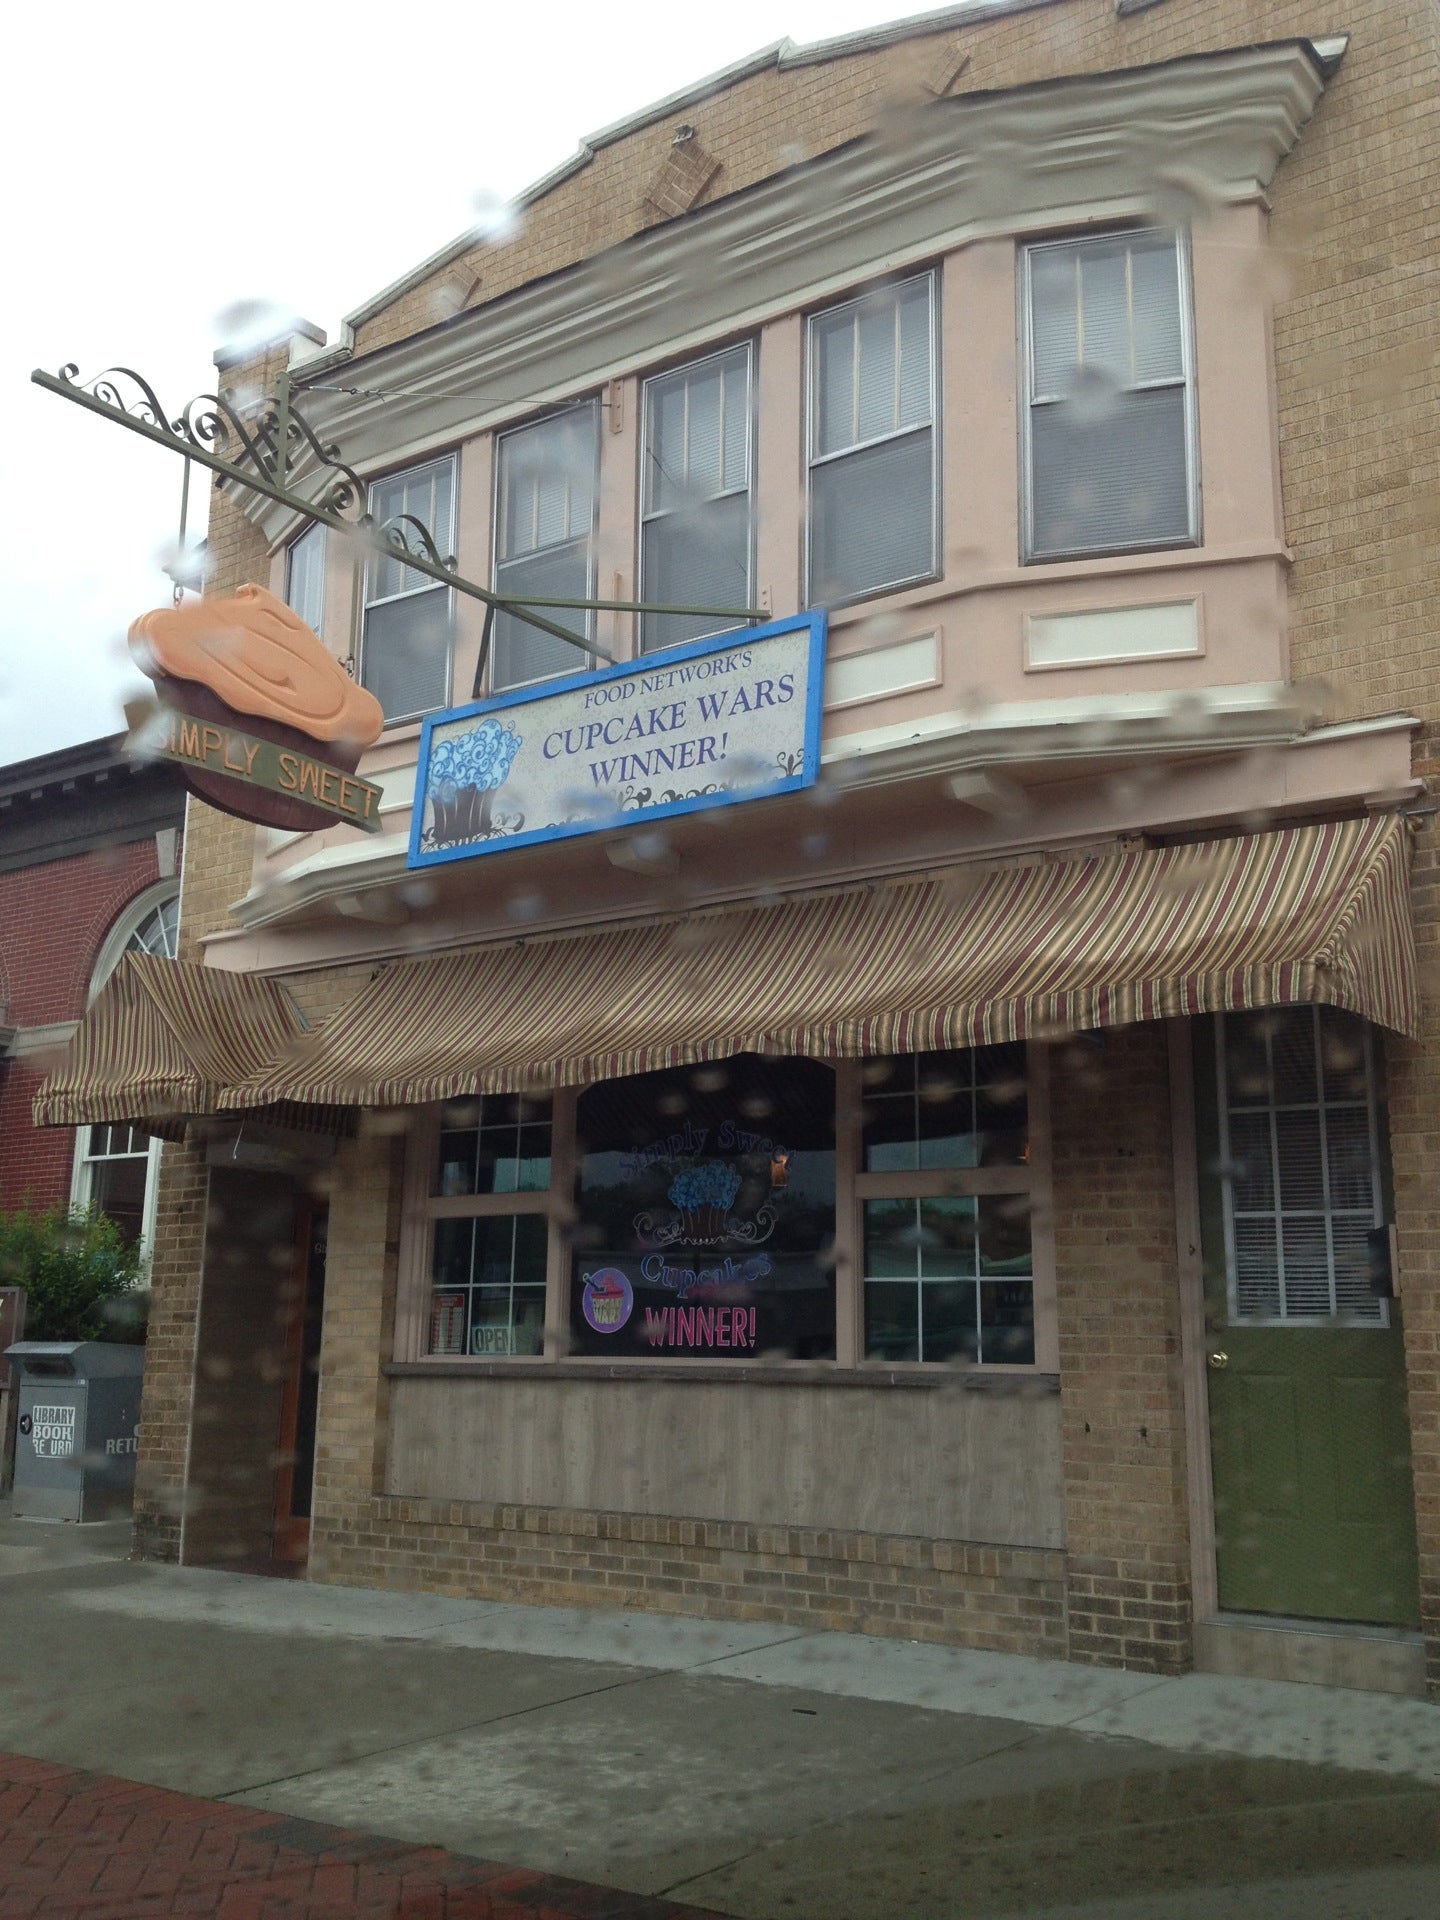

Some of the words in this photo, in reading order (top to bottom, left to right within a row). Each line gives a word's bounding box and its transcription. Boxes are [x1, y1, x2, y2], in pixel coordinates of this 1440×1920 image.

[584, 680, 636, 709] FOOD
[640, 650, 753, 696] NETWORK'S
[542, 700, 687, 760] CUPCAKE
[696, 674, 795, 722] WARS
[589, 731, 729, 788] WINNER!
[278, 753, 378, 819] SWEET
[475, 1328, 515, 1352] OPEN
[645, 1306, 756, 1348] WINNER!
[33, 1407, 74, 1424] LIBRARY
[33, 1425, 72, 1440] BOOK
[32, 1439, 73, 1456] REURN
